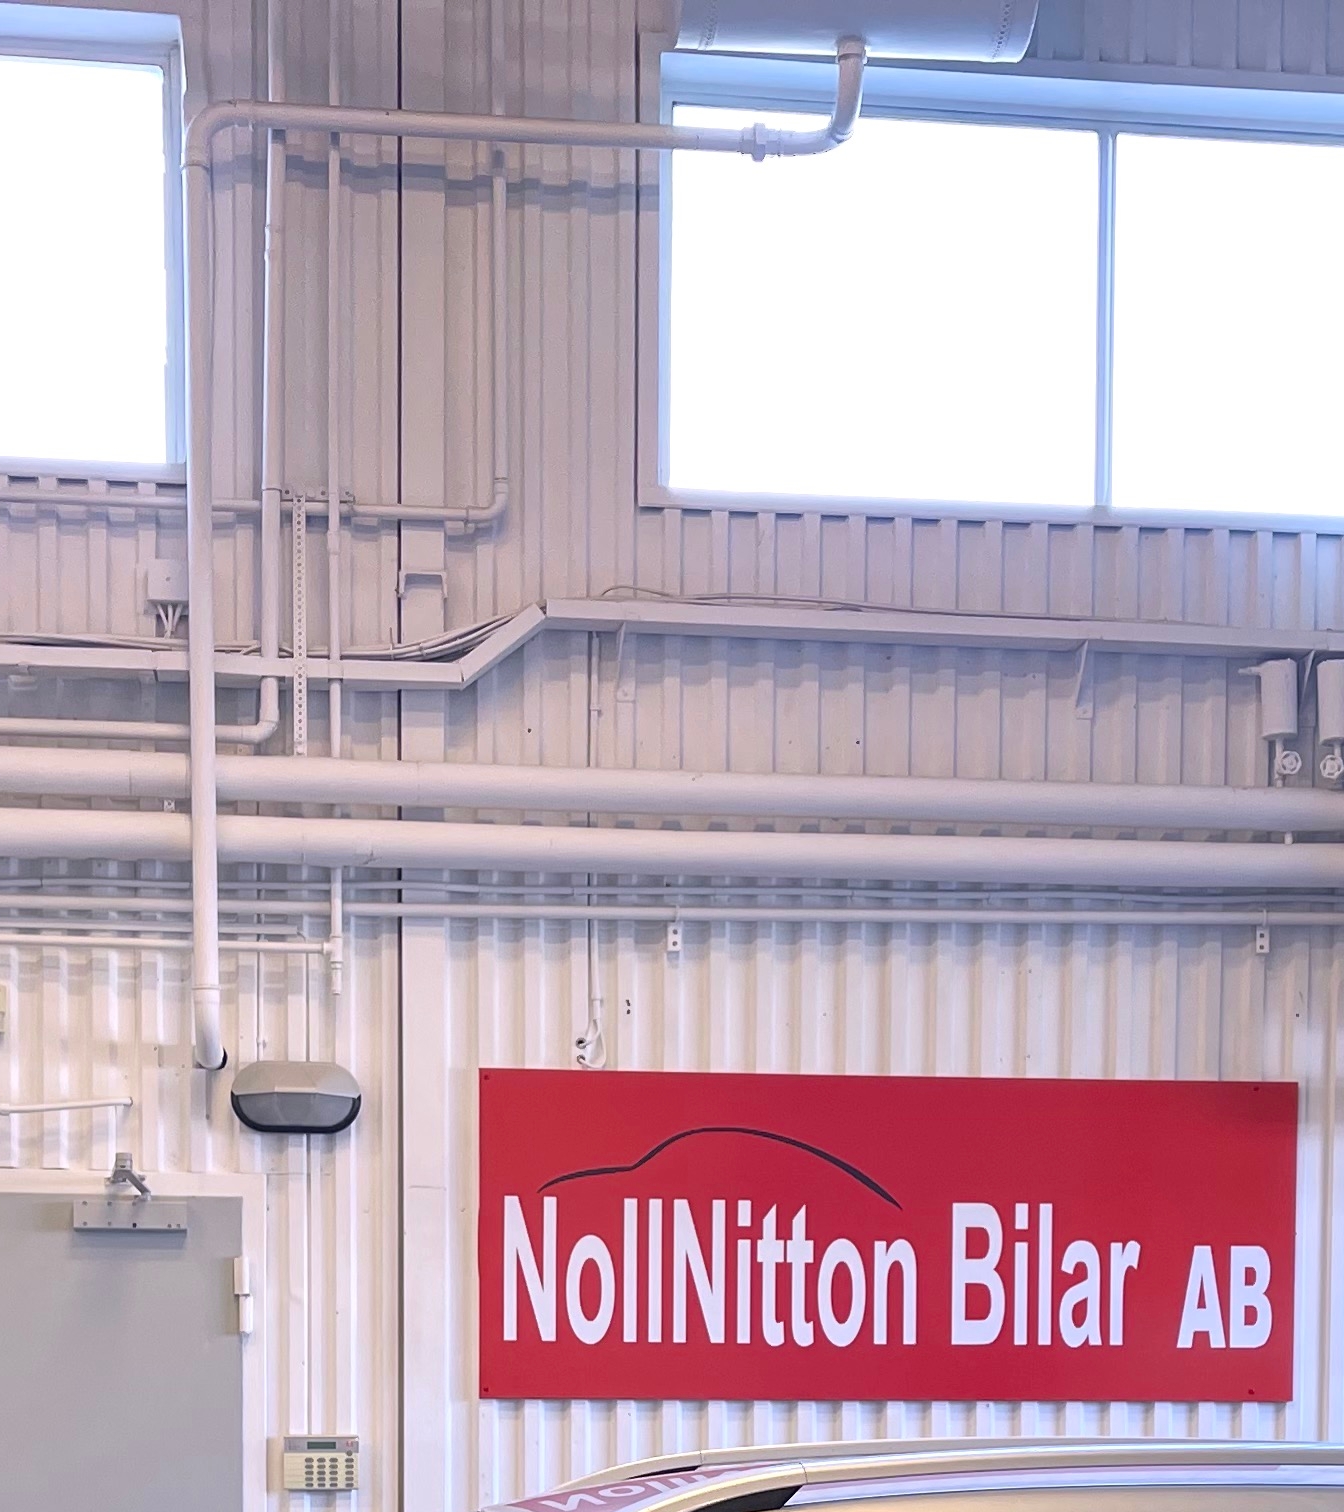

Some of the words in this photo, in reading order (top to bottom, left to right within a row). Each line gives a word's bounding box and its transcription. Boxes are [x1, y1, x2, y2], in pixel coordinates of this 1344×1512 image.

[503, 1194, 918, 1347] NollNitton
[951, 1201, 1141, 1348] Bilar
[1177, 1245, 1273, 1349] AB
